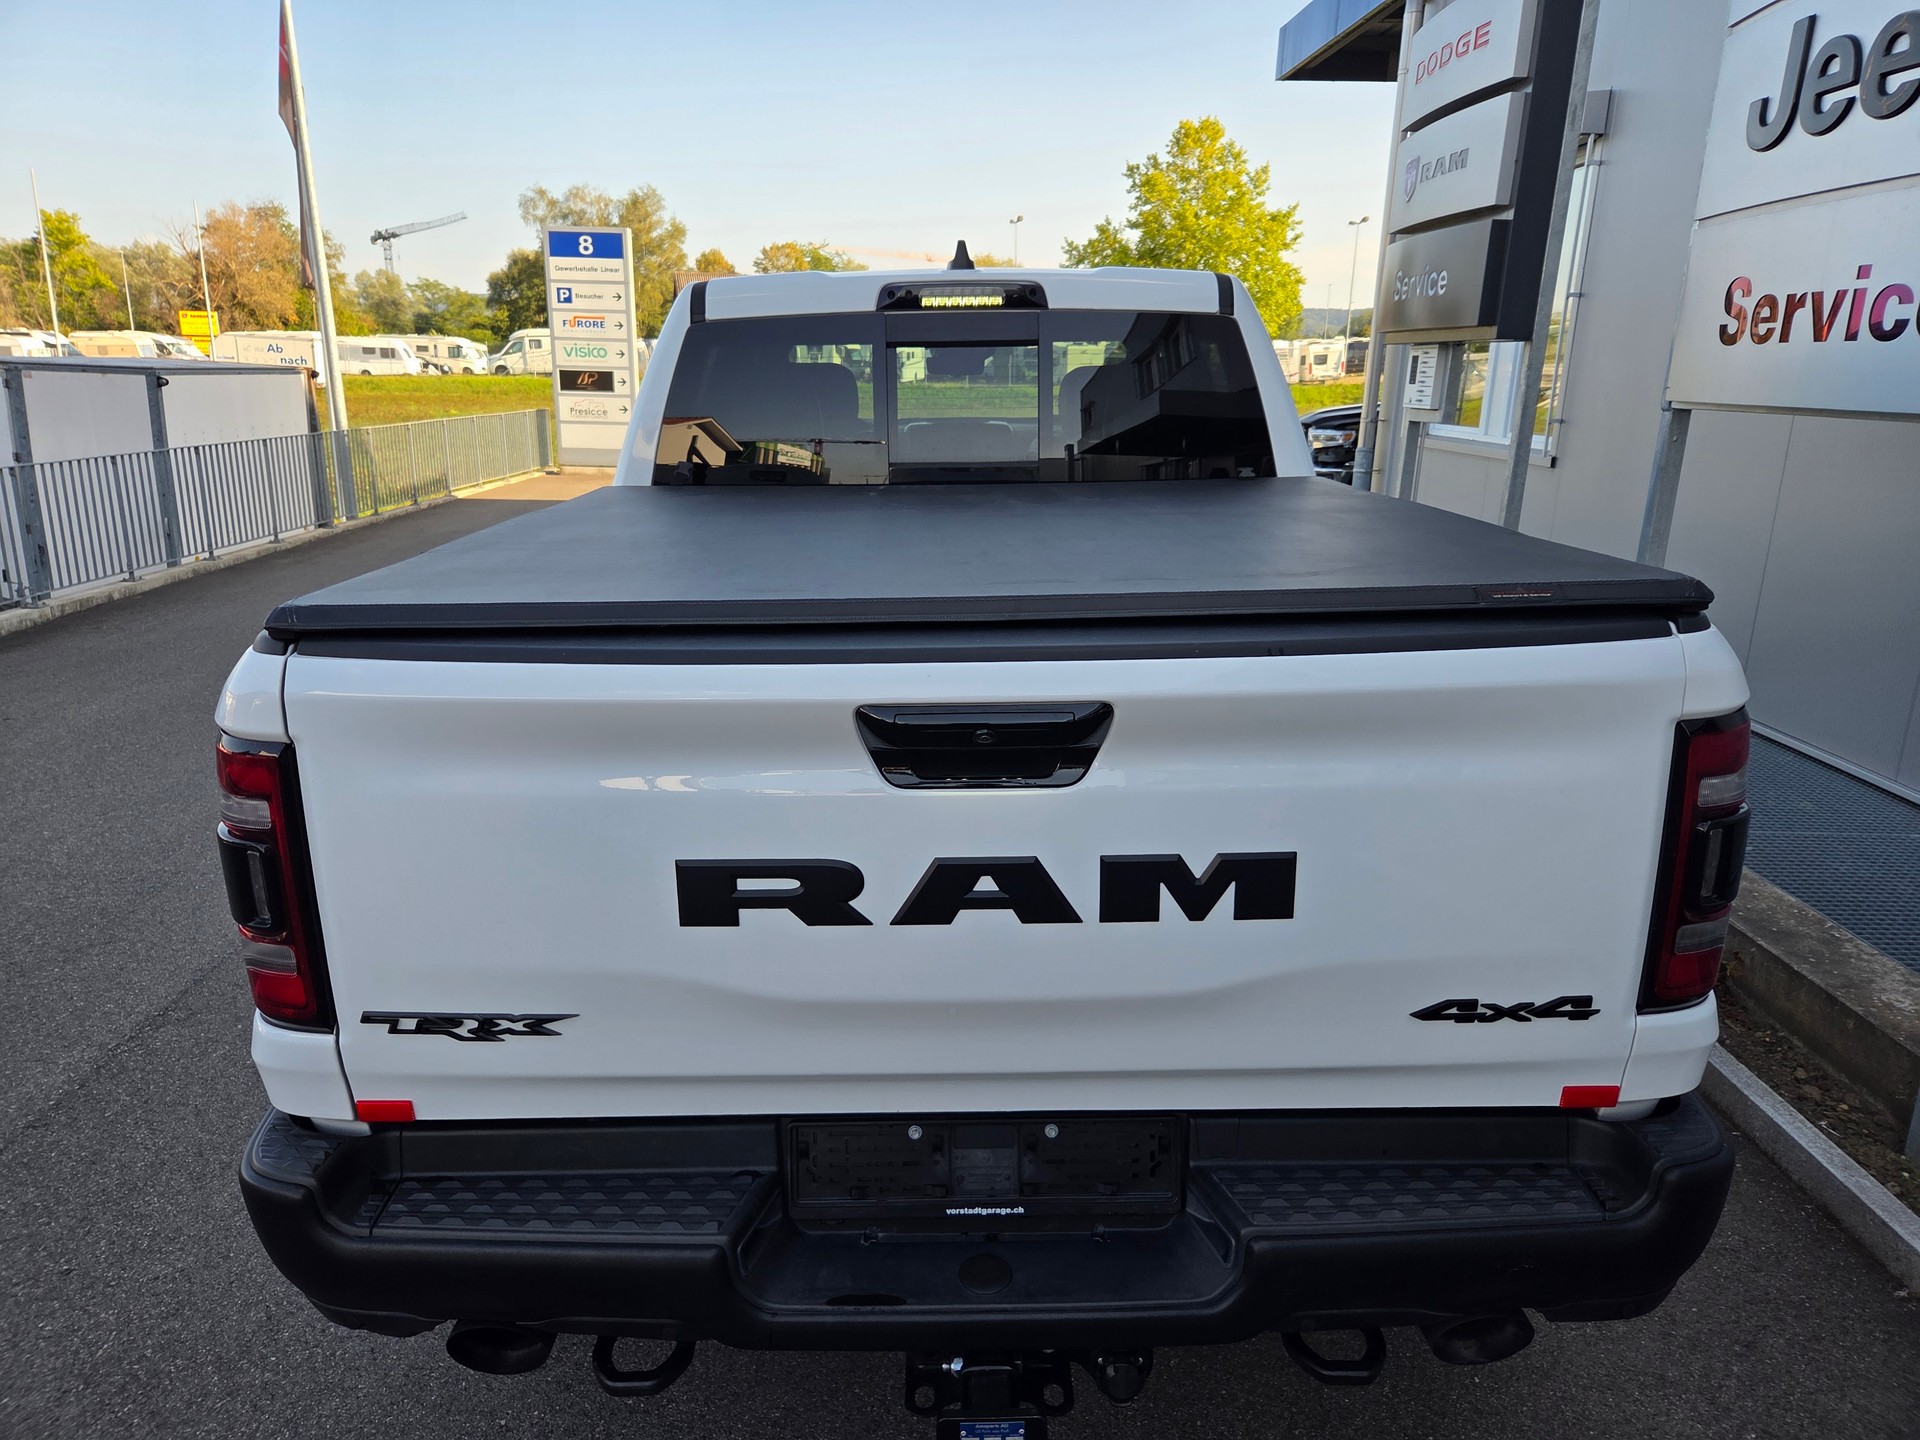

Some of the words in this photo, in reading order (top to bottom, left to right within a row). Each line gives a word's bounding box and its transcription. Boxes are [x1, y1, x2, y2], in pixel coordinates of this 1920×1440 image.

[1415, 20, 1492, 85] DODGE
[1420, 148, 1470, 183] RAM
[578, 235, 594, 255] 8
[560, 288, 570, 301] P
[1393, 264, 1448, 301] Service
[1719, 264, 1920, 346] Servic
[562, 316, 606, 329] FURORE
[267, 343, 284, 354] Ab
[280, 356, 308, 365] nach
[570, 407, 609, 416] Presicce
[674, 851, 1298, 927] RAM
[1409, 995, 1601, 1024] 4x4
[360, 1010, 580, 1042] TRX
[946, 1206, 1025, 1216] vorstadtgarage.ch
